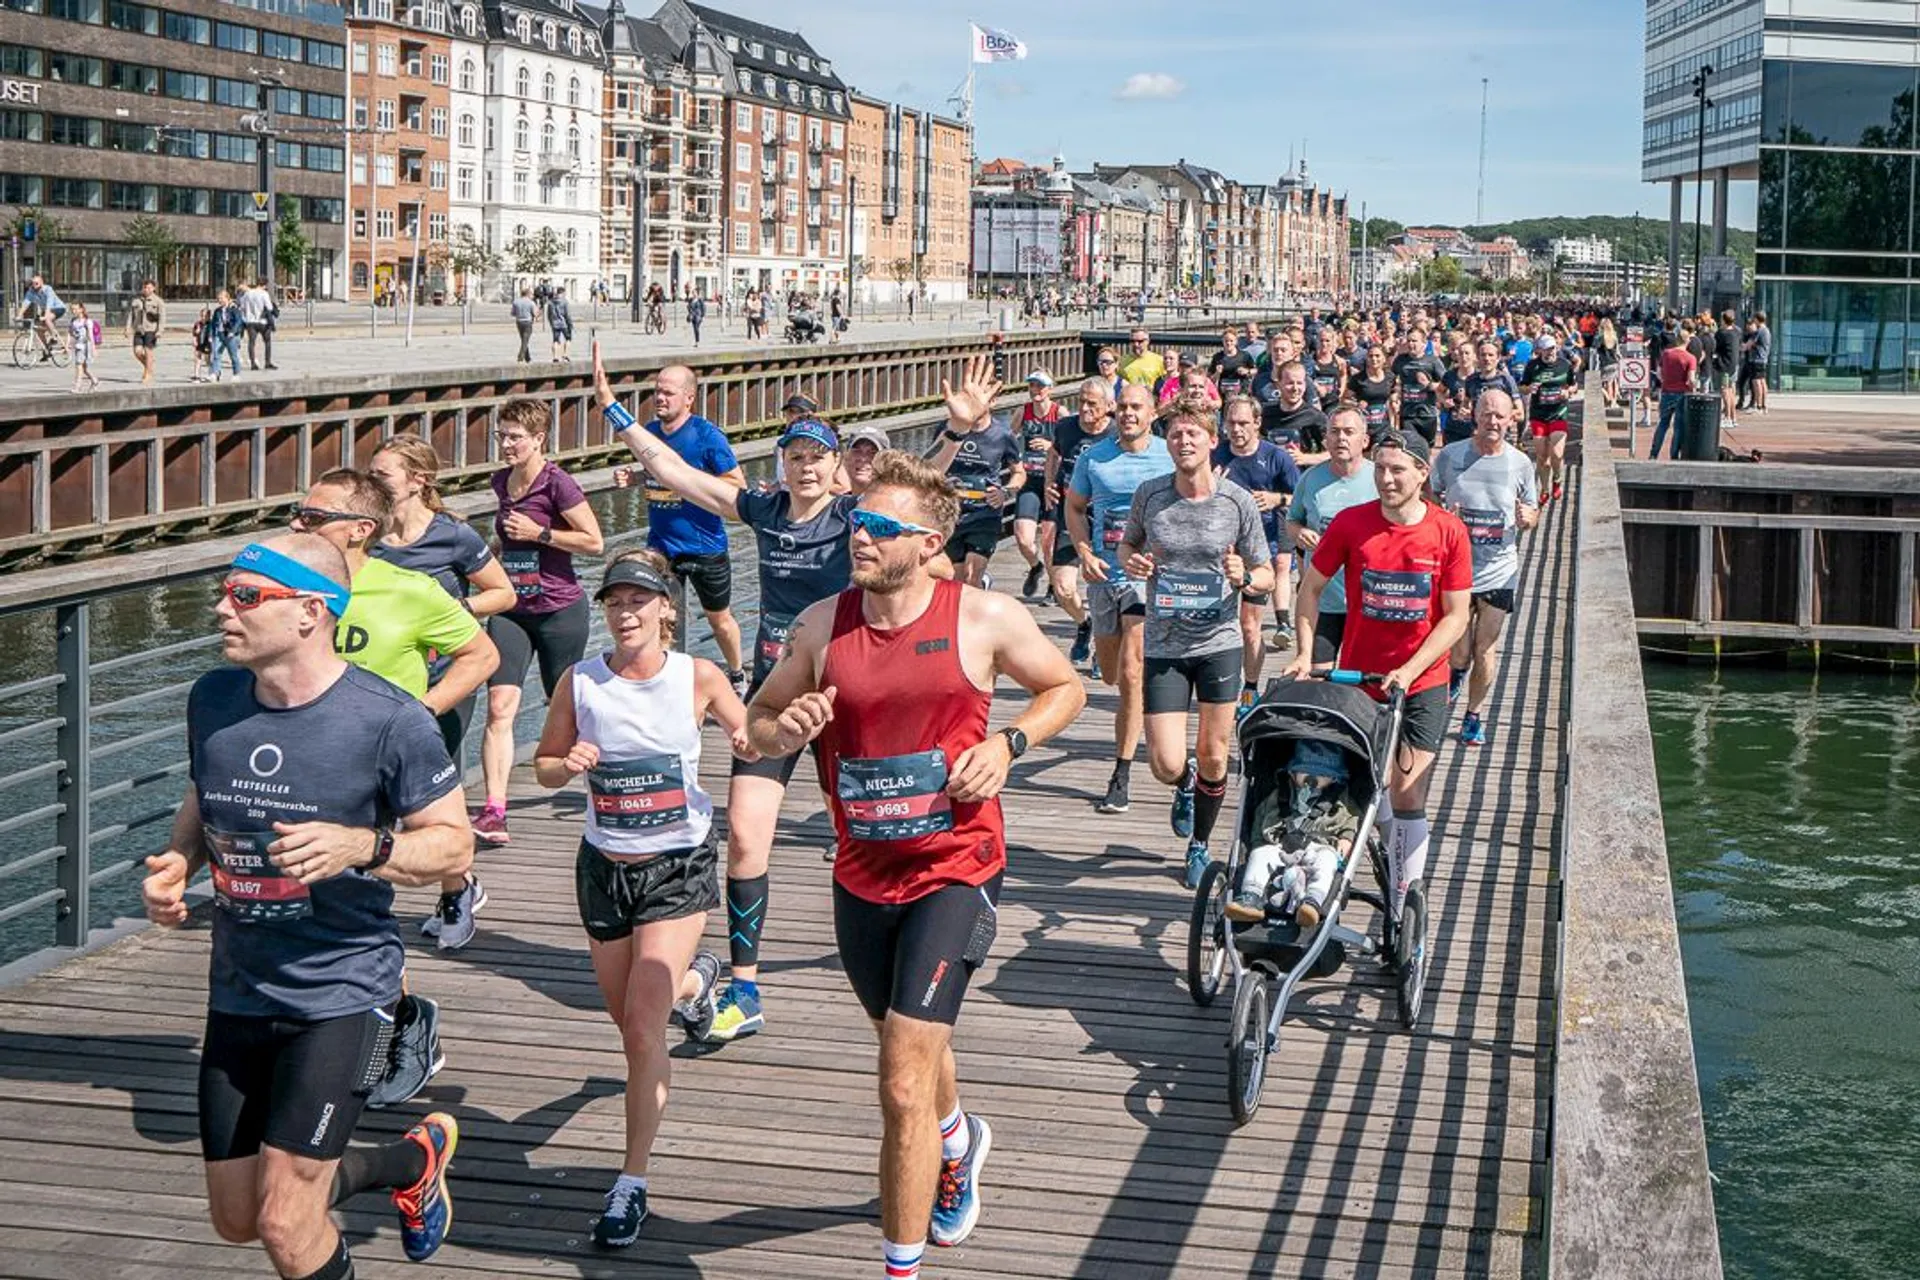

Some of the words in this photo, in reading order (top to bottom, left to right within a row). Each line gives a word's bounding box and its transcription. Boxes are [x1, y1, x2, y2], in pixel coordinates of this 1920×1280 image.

[1173, 583, 1208, 592] THOMAS
[1374, 583, 1416, 592] ANDREAS
[231, 779, 291, 794] BESTSELLER
[604, 773, 664, 788] MICHELLE
[865, 775, 915, 791] NICLAS
[204, 791, 232, 801] Aarhus
[234, 794, 252, 806] City
[253, 797, 318, 812] Halvmarathon
[618, 798, 654, 810] 10412
[247, 808, 267, 818] 2019
[875, 802, 910, 817] 9693
[222, 853, 264, 867] PETER
[230, 880, 262, 895] 8167
